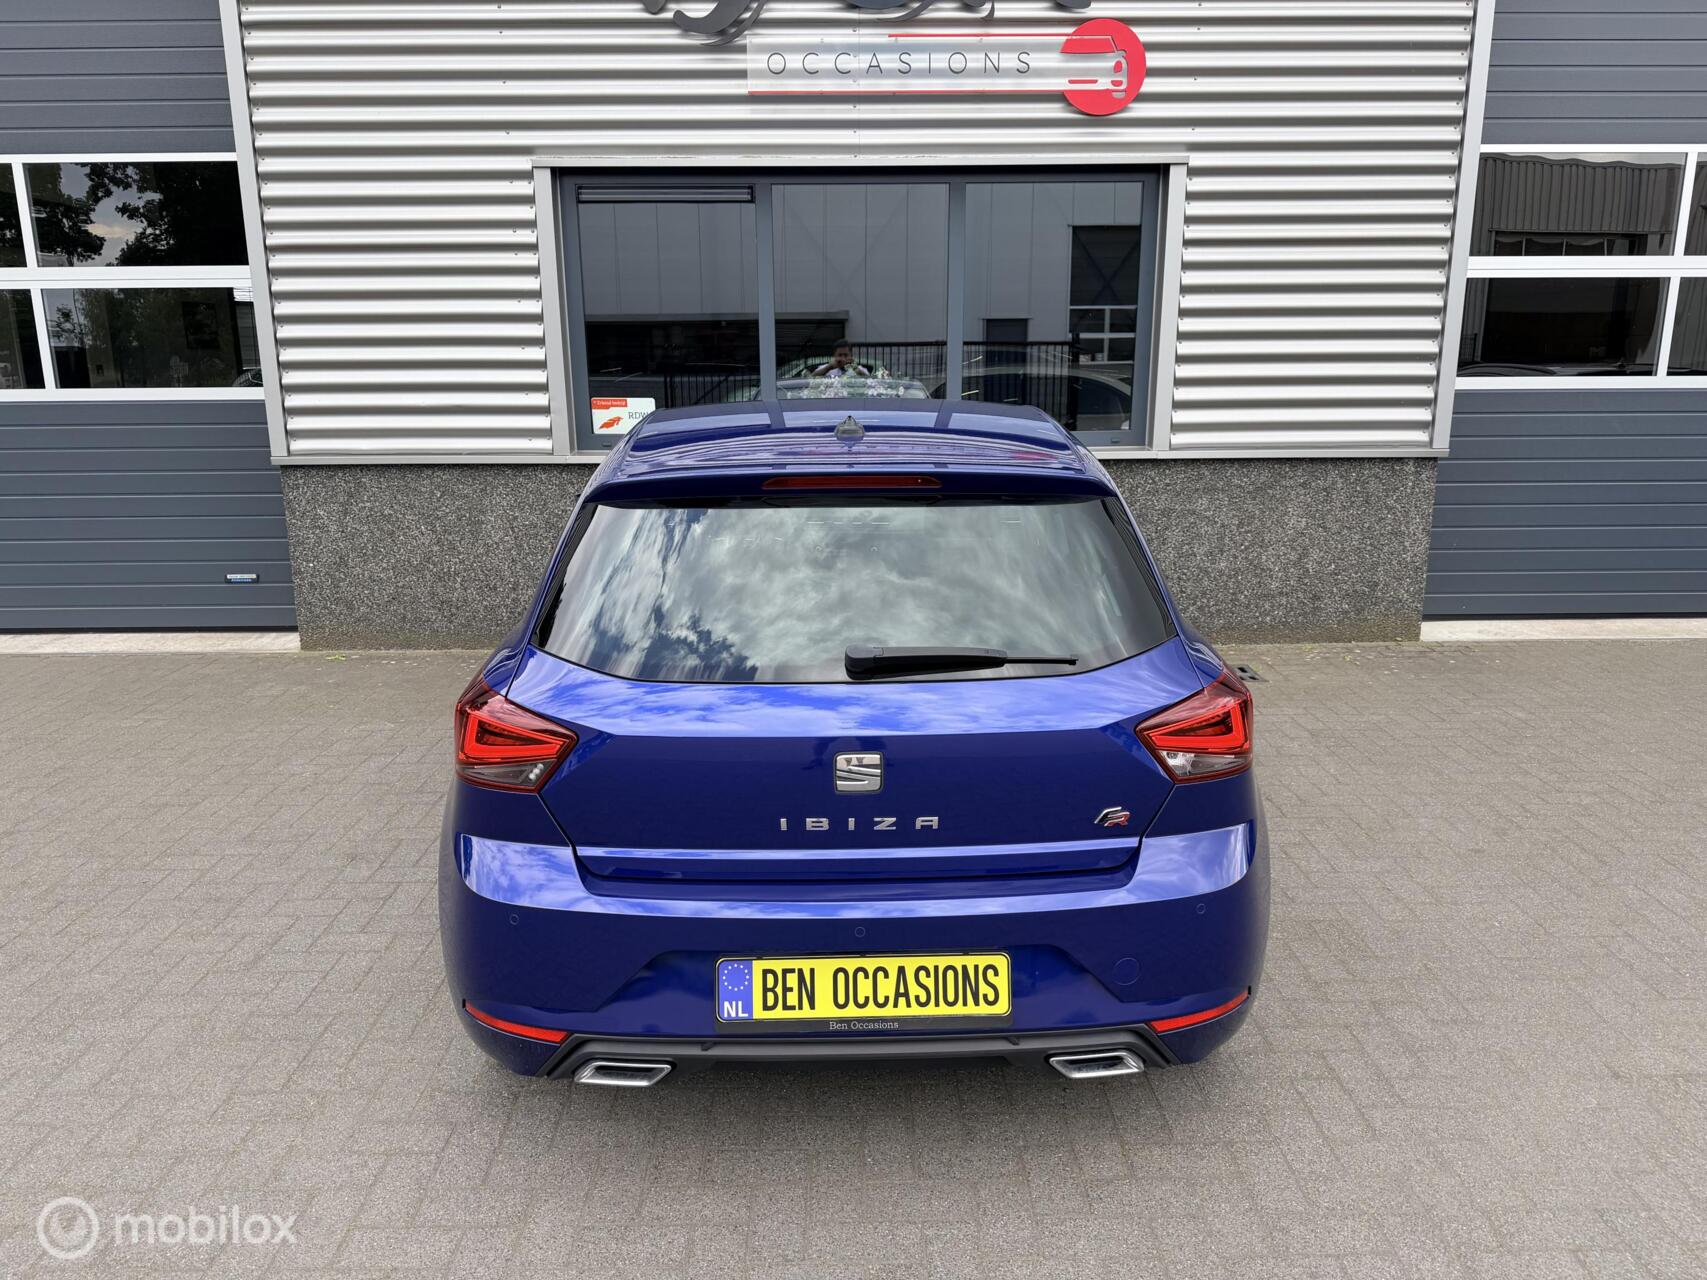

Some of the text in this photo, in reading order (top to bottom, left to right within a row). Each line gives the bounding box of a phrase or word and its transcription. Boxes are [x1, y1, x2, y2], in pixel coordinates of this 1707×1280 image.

[767, 51, 1031, 74] OCCASIONS
[779, 816, 940, 832] IBIZA
[762, 964, 1000, 1012] BEN OCCASIONS
[724, 1001, 749, 1018] NL
[829, 1019, 899, 1030] Ben Occasions
